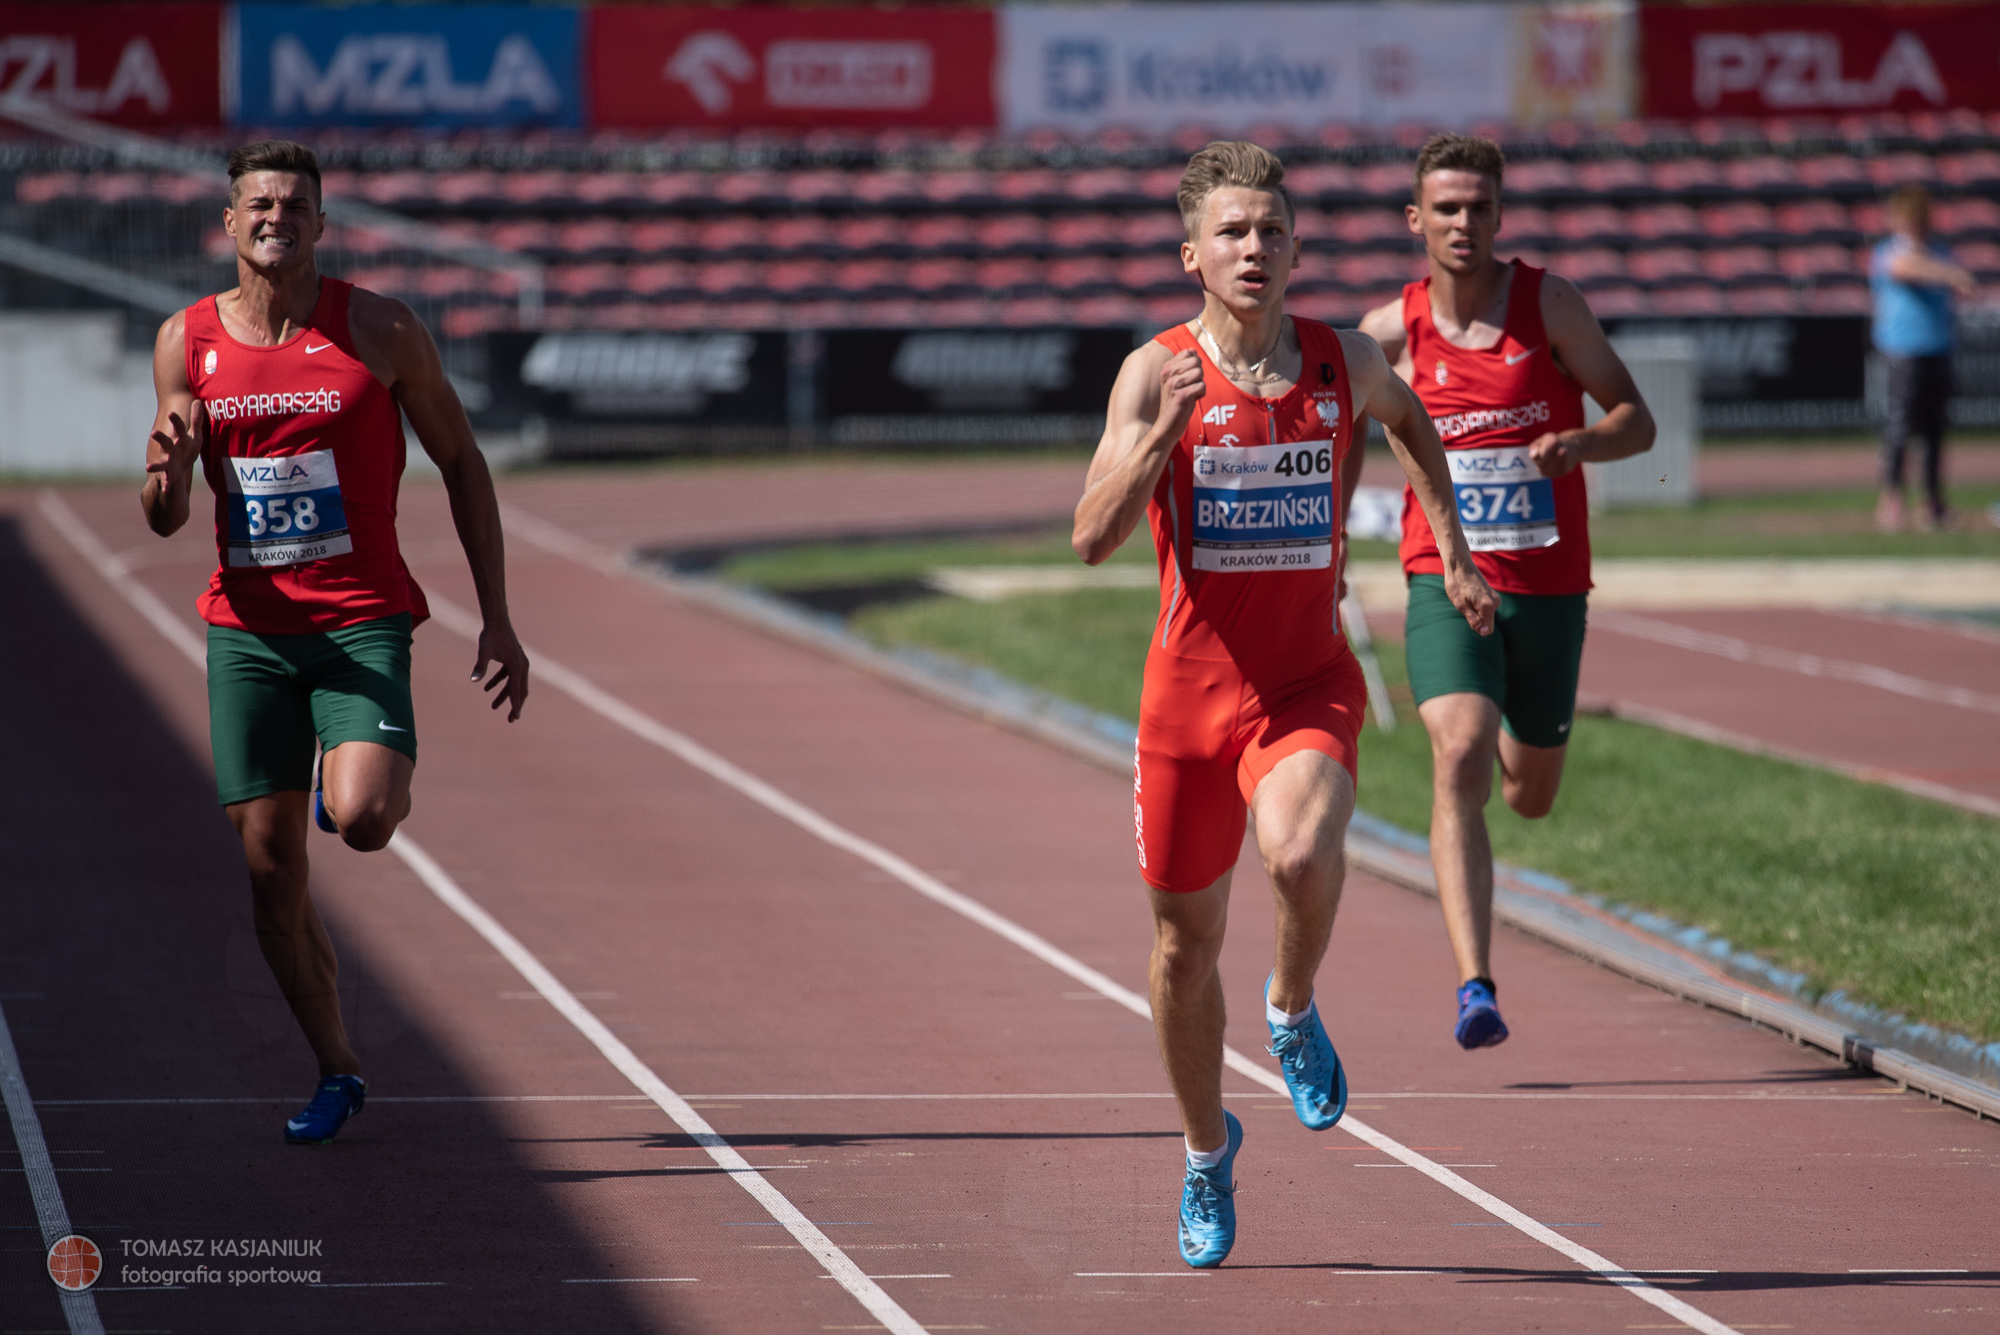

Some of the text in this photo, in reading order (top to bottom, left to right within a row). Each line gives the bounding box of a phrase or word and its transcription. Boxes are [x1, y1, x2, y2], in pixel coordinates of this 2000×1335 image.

[269, 34, 562, 115] MZLA
[1693, 30, 1948, 109] PZLA
[205, 388, 341, 420] MAGYARORSZÁG
[1313, 390, 1337, 399] POLSKA
[1203, 404, 1238, 426] 4F
[239, 464, 309, 482] MZLA
[1221, 448, 1331, 477] Kraków 406
[1457, 456, 1526, 472] MZLA
[247, 496, 320, 536] 358
[1198, 493, 1331, 529] BRZEZIŃSKI
[1459, 485, 1533, 522] 374
[249, 545, 326, 563] KRAKÓW 2018
[1220, 553, 1311, 567] KRAKÓW 2018
